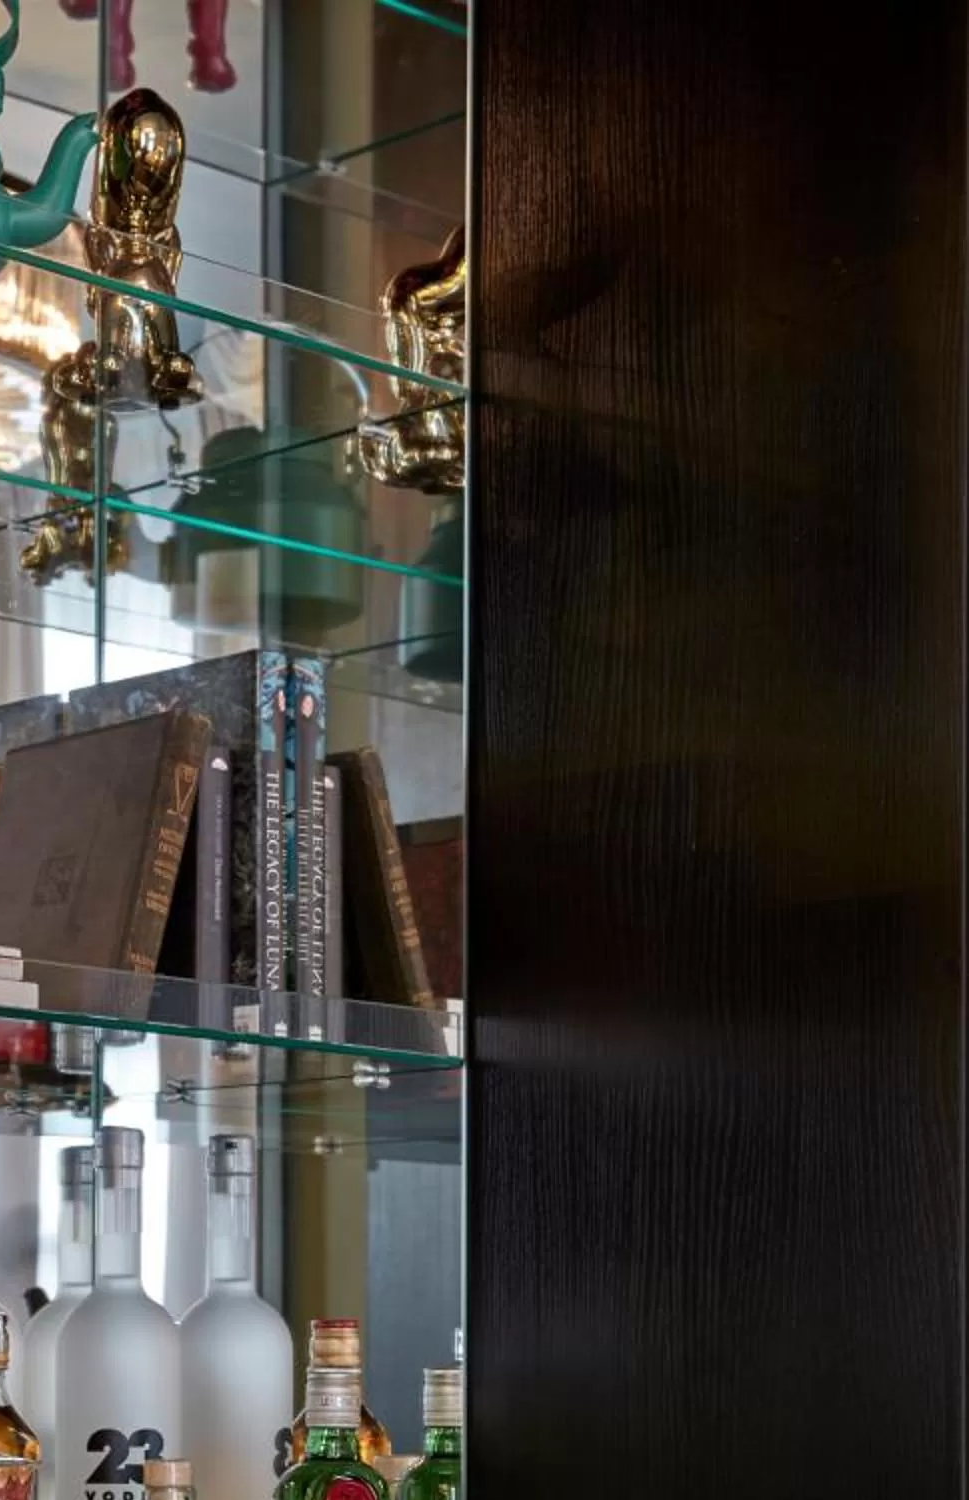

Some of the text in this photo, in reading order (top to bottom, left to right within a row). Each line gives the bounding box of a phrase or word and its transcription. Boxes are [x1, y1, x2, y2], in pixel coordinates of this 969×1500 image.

[265, 771, 280, 992] THE LEGACY OF LUNA
